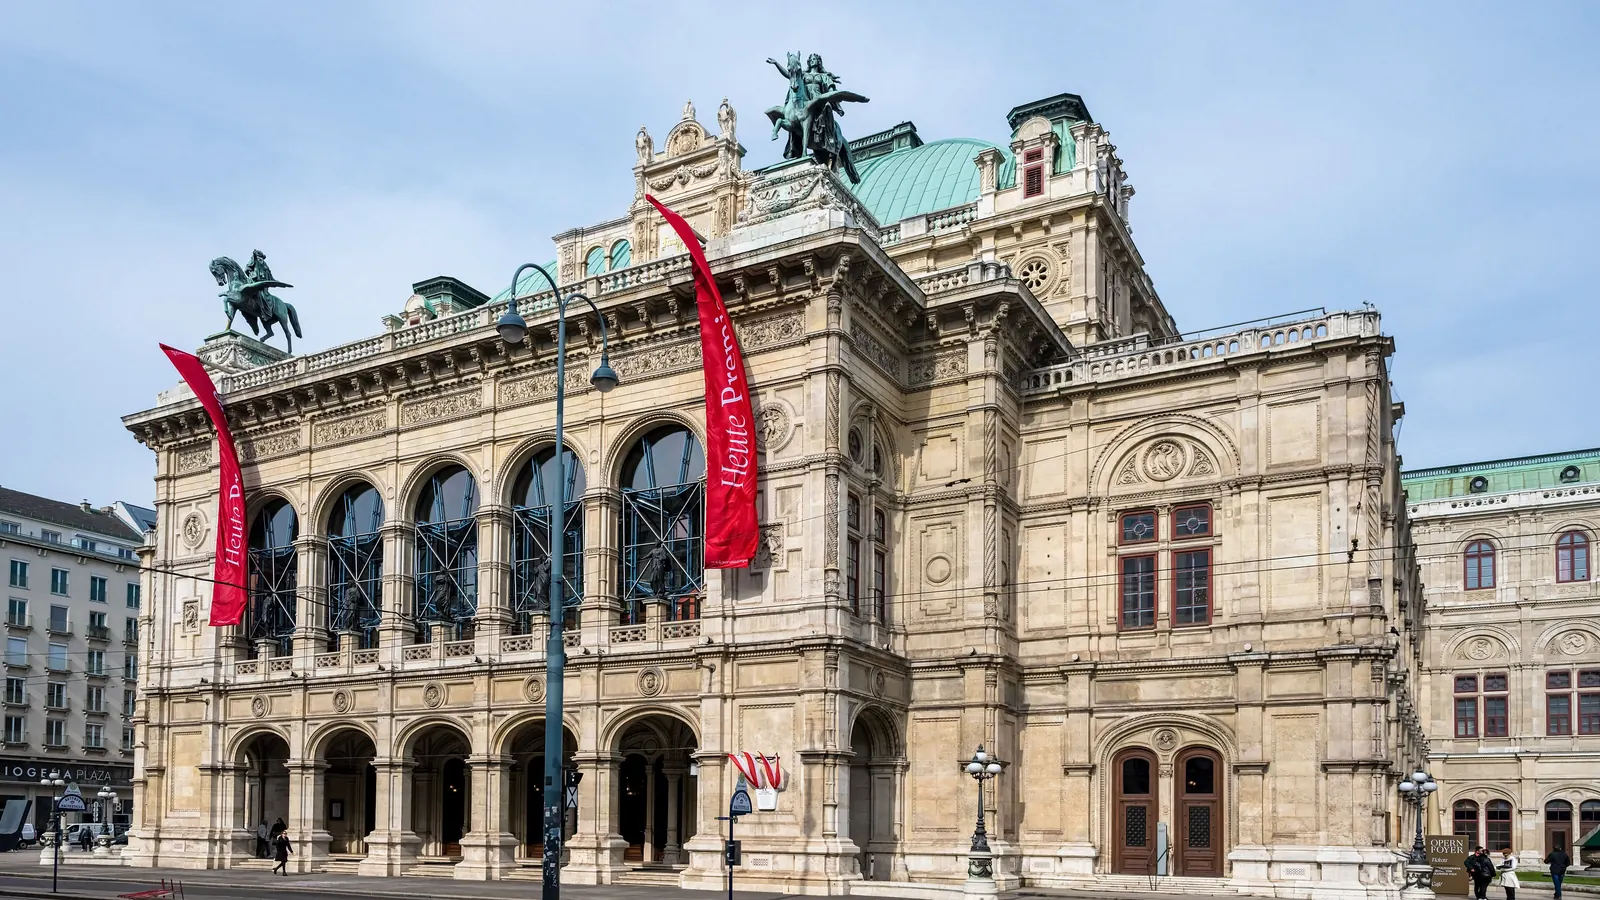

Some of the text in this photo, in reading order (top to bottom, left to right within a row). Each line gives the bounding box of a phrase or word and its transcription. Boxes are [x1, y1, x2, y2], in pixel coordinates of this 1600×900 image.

[721, 414, 749, 488] Heute
[225, 507, 243, 567] Heute
[76, 769, 112, 781] PLAZA
[1431, 839, 1463, 847] OPERN
